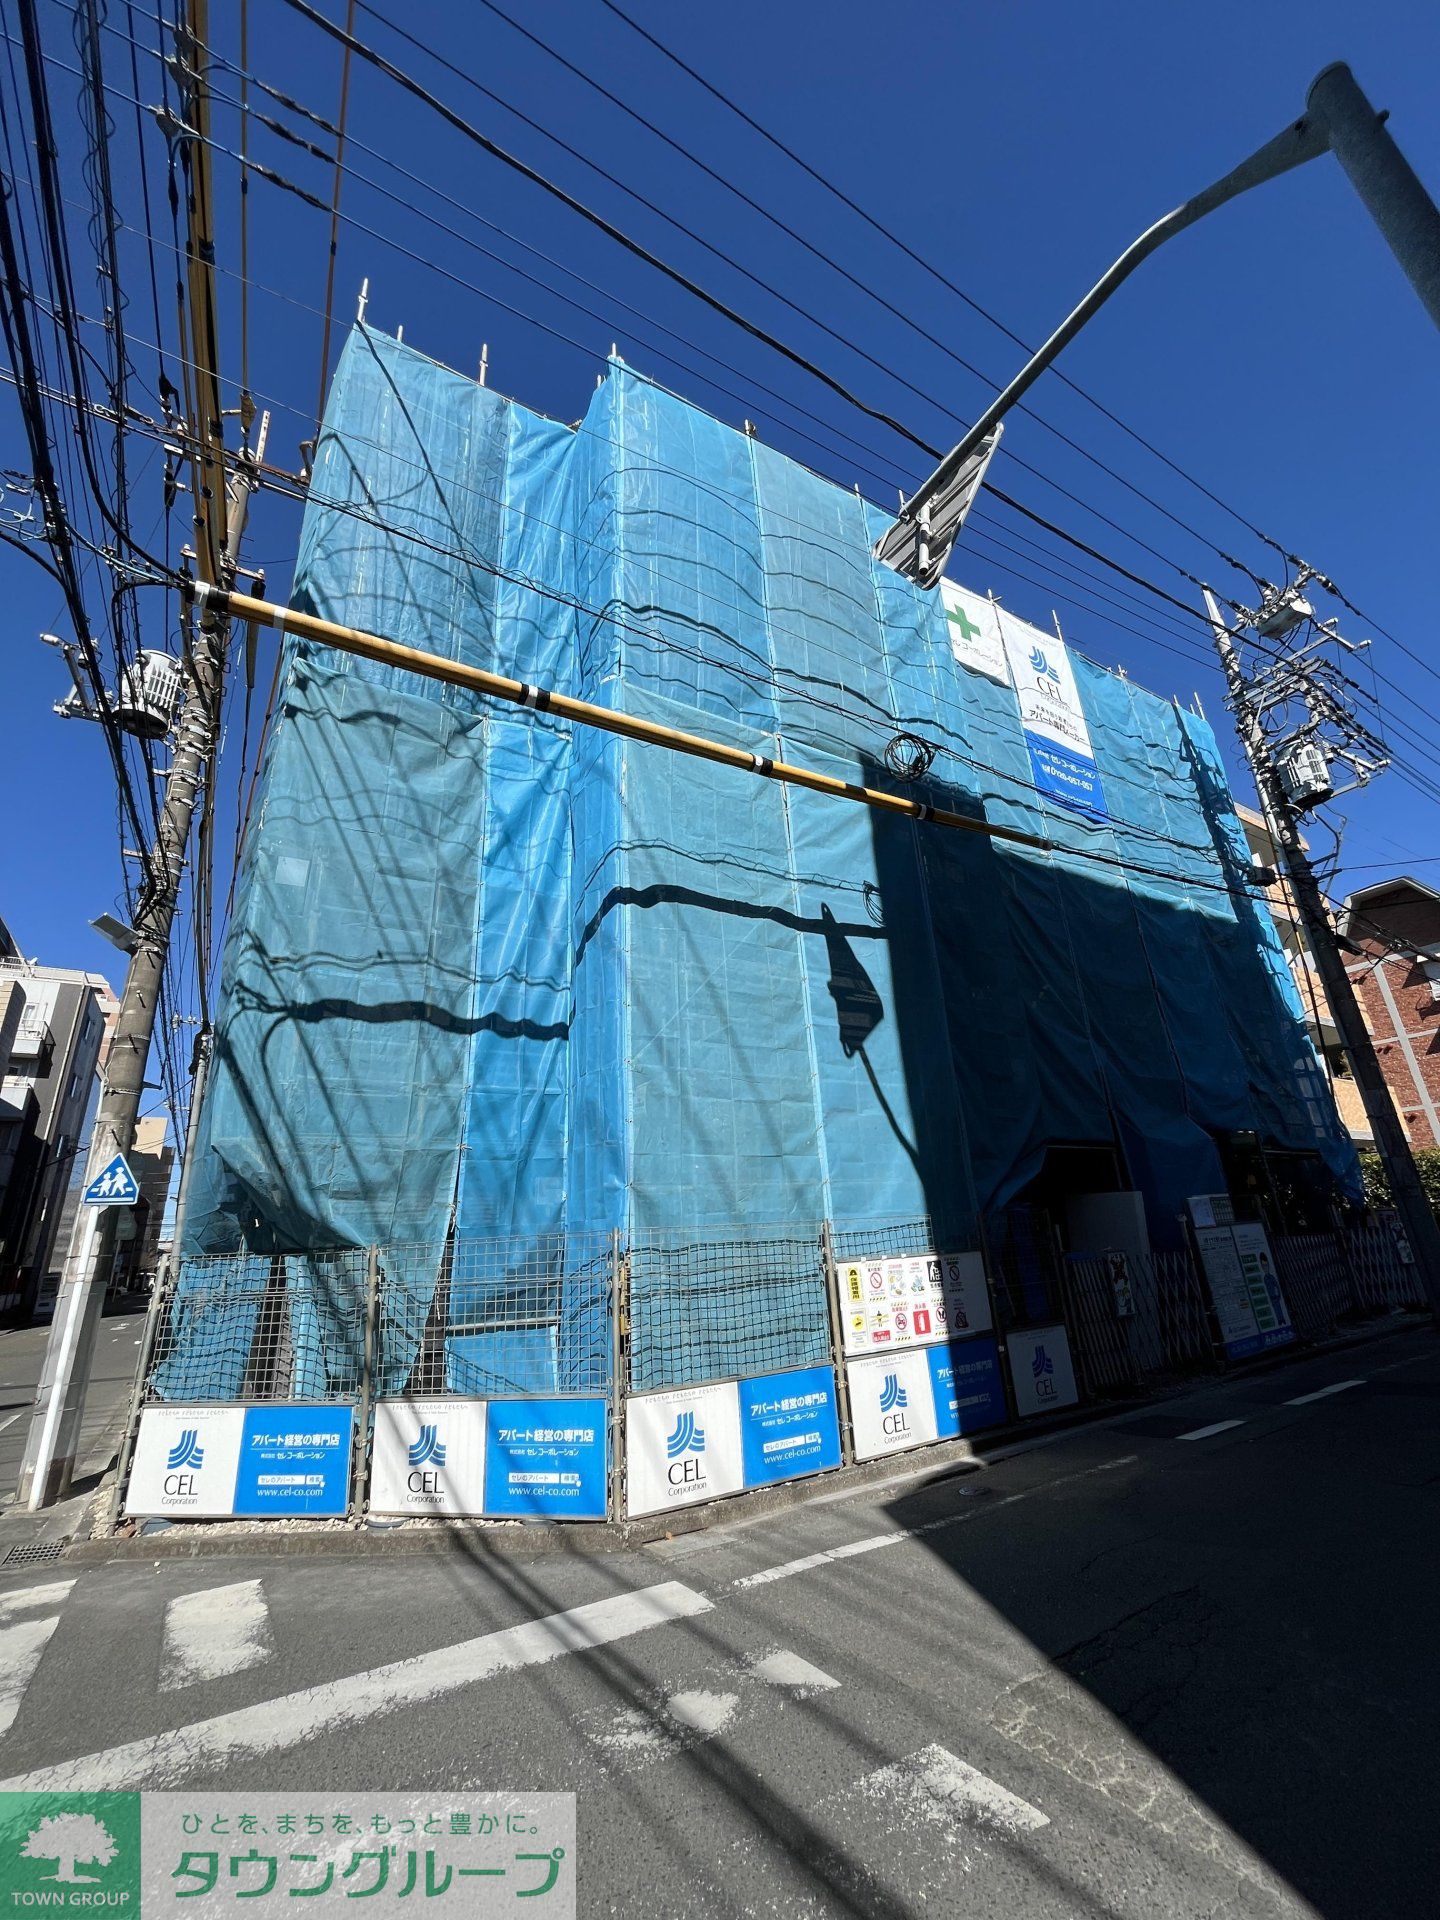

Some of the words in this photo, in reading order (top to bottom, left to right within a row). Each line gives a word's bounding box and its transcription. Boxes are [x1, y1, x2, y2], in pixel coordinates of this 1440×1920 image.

[1036, 1378, 1058, 1397] CEL
[750, 1391, 828, 1417] アパート経営の専門店
[882, 1412, 911, 1435] CEL
[251, 1433, 340, 1447] アパート経営の専門店
[498, 1428, 595, 1442] アパート経営の専門店
[884, 1432, 912, 1445] Corporation
[763, 1445, 821, 1464] www.cel-co.com
[668, 1458, 706, 1485] CEL
[163, 1474, 199, 1496] CEL
[407, 1471, 445, 1493] CEL
[668, 1482, 707, 1497] Corporation
[257, 1486, 323, 1496] www.cel-co.com
[508, 1486, 580, 1496] www.cel-co.com
[161, 1496, 198, 1507] Corporation
[406, 1494, 445, 1504] Corporation
